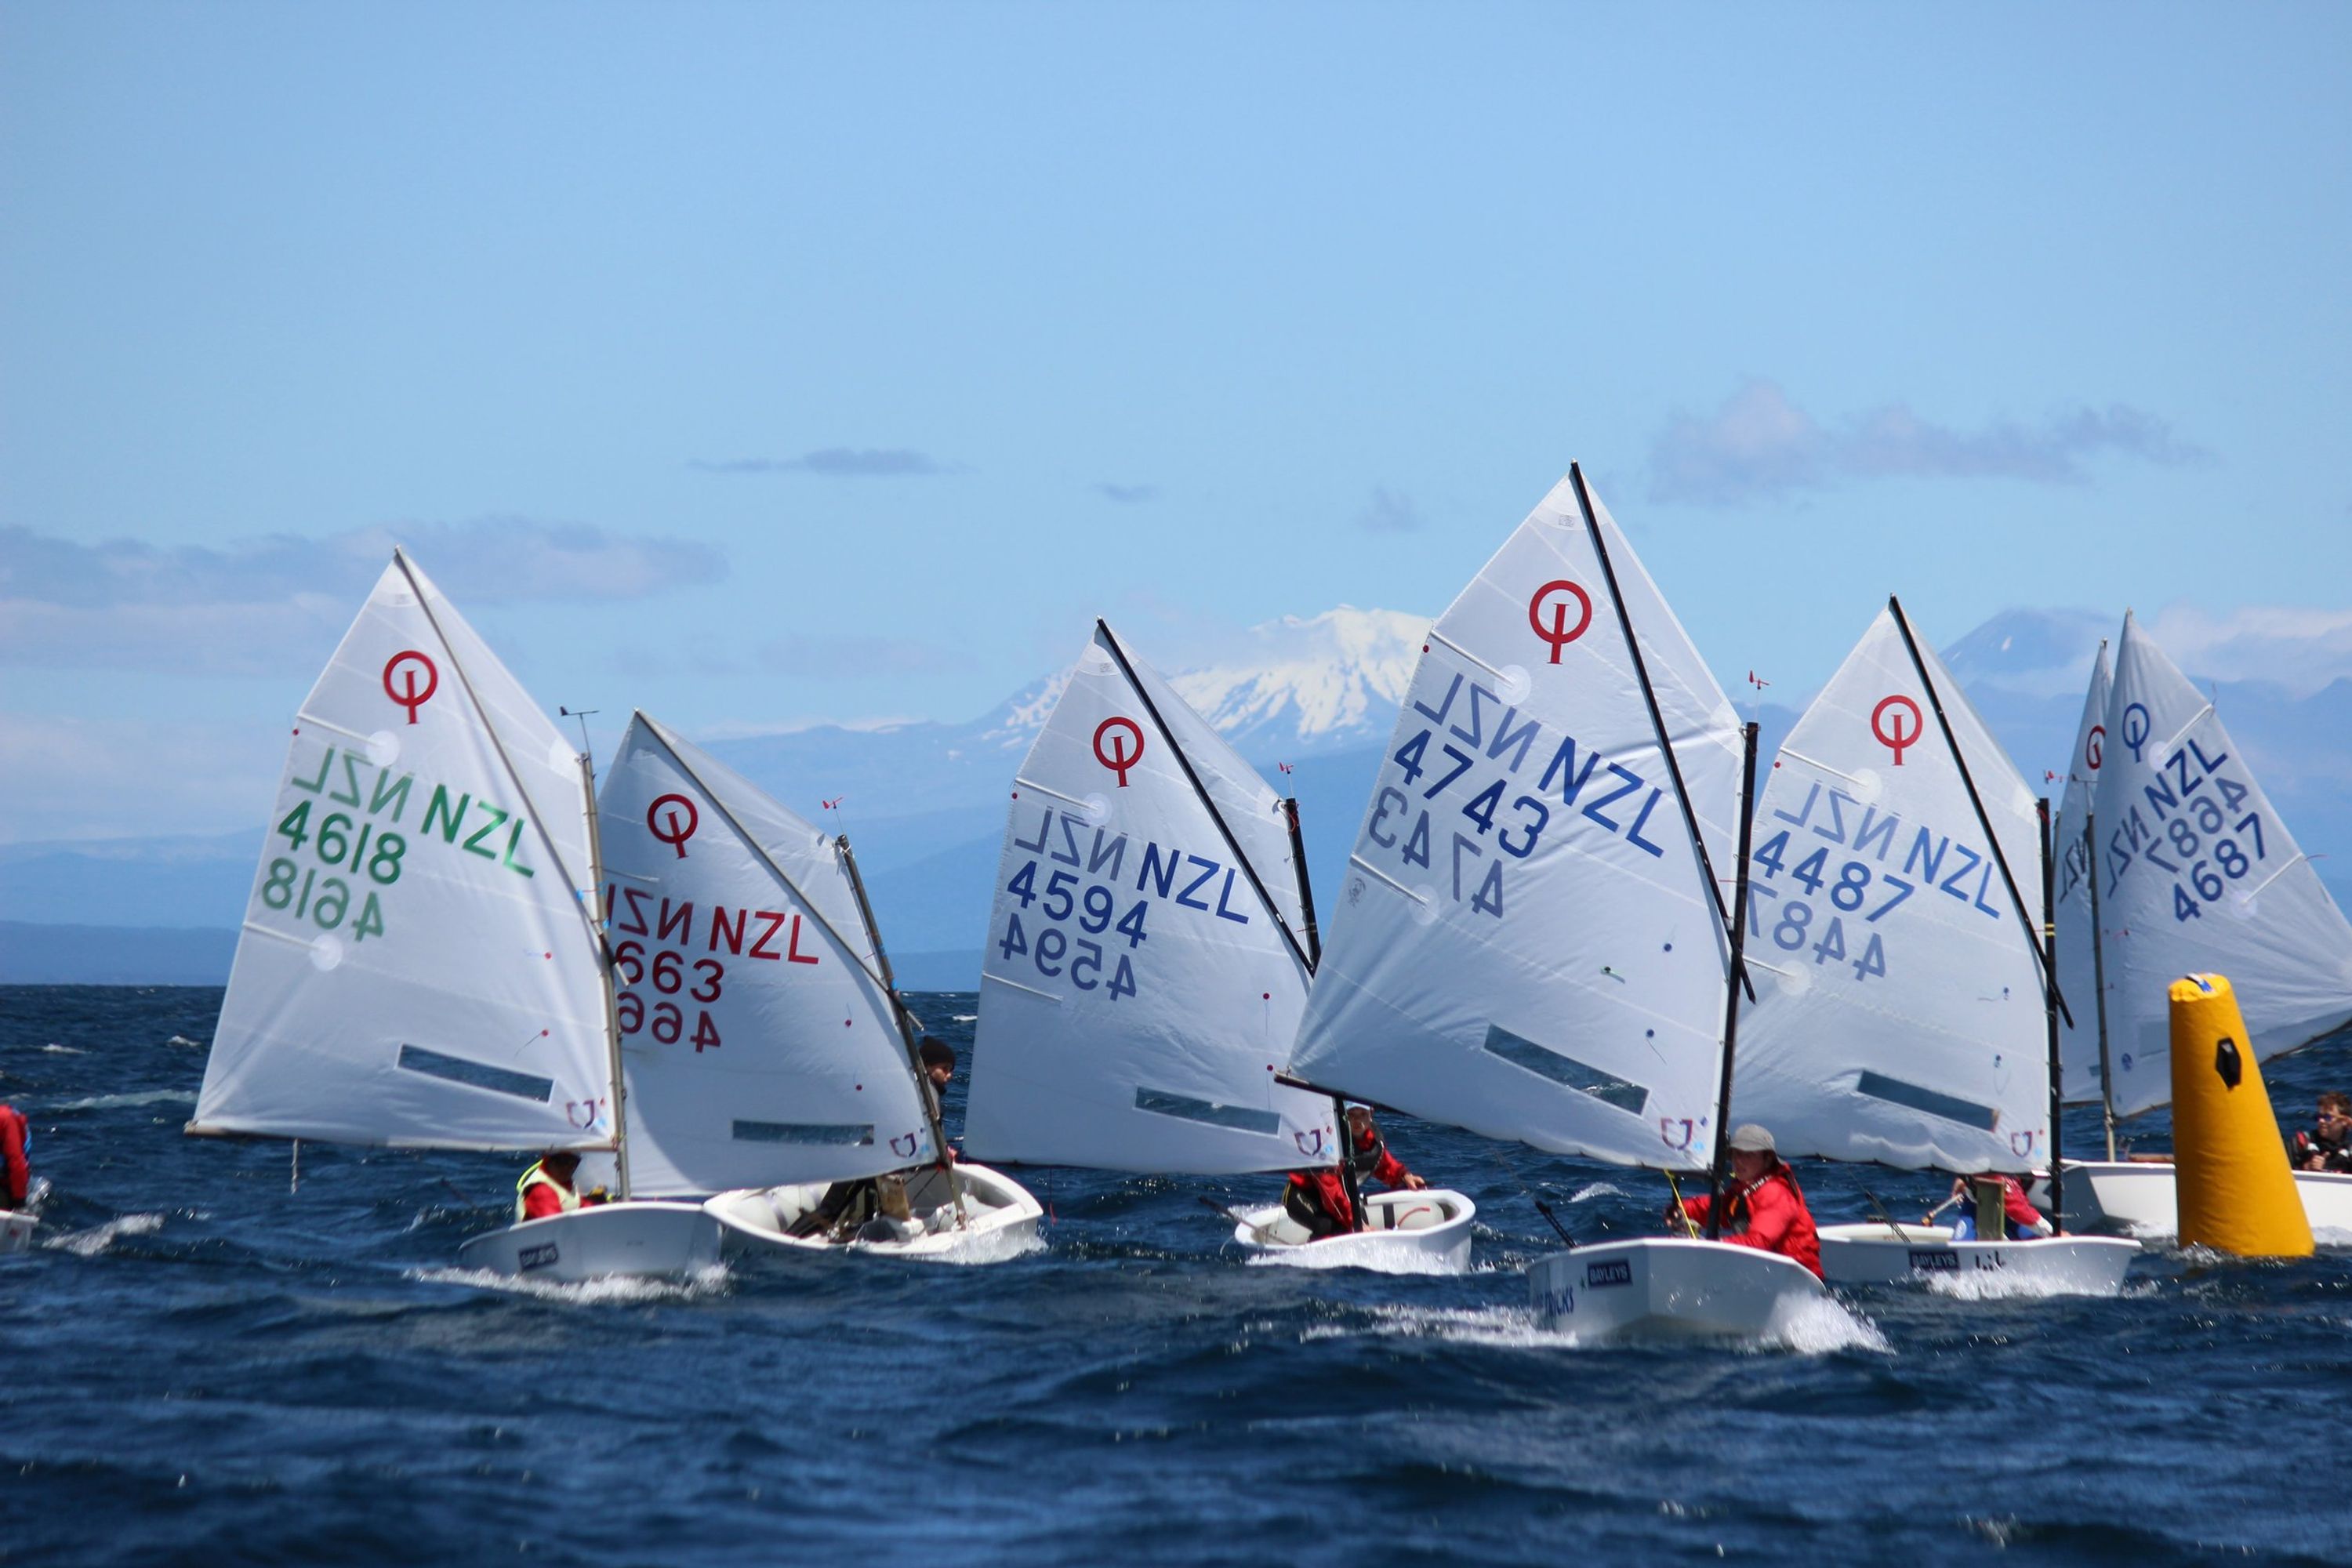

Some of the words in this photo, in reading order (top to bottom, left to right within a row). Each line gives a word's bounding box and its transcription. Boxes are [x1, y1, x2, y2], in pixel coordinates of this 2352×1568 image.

[1393, 729, 1550, 858] 4743
[1537, 735, 1664, 858] NZL
[2144, 739, 2228, 821] NZL
[278, 800, 407, 884] 4618
[421, 784, 535, 878] NZL
[1753, 830, 1915, 923] 4487
[1904, 826, 2000, 920] NZL
[2173, 812, 2266, 923] 4687
[1007, 860, 1149, 949] 4594
[1136, 841, 1249, 925] NZL
[615, 940, 724, 1003] 663
[709, 906, 819, 964] NZL
